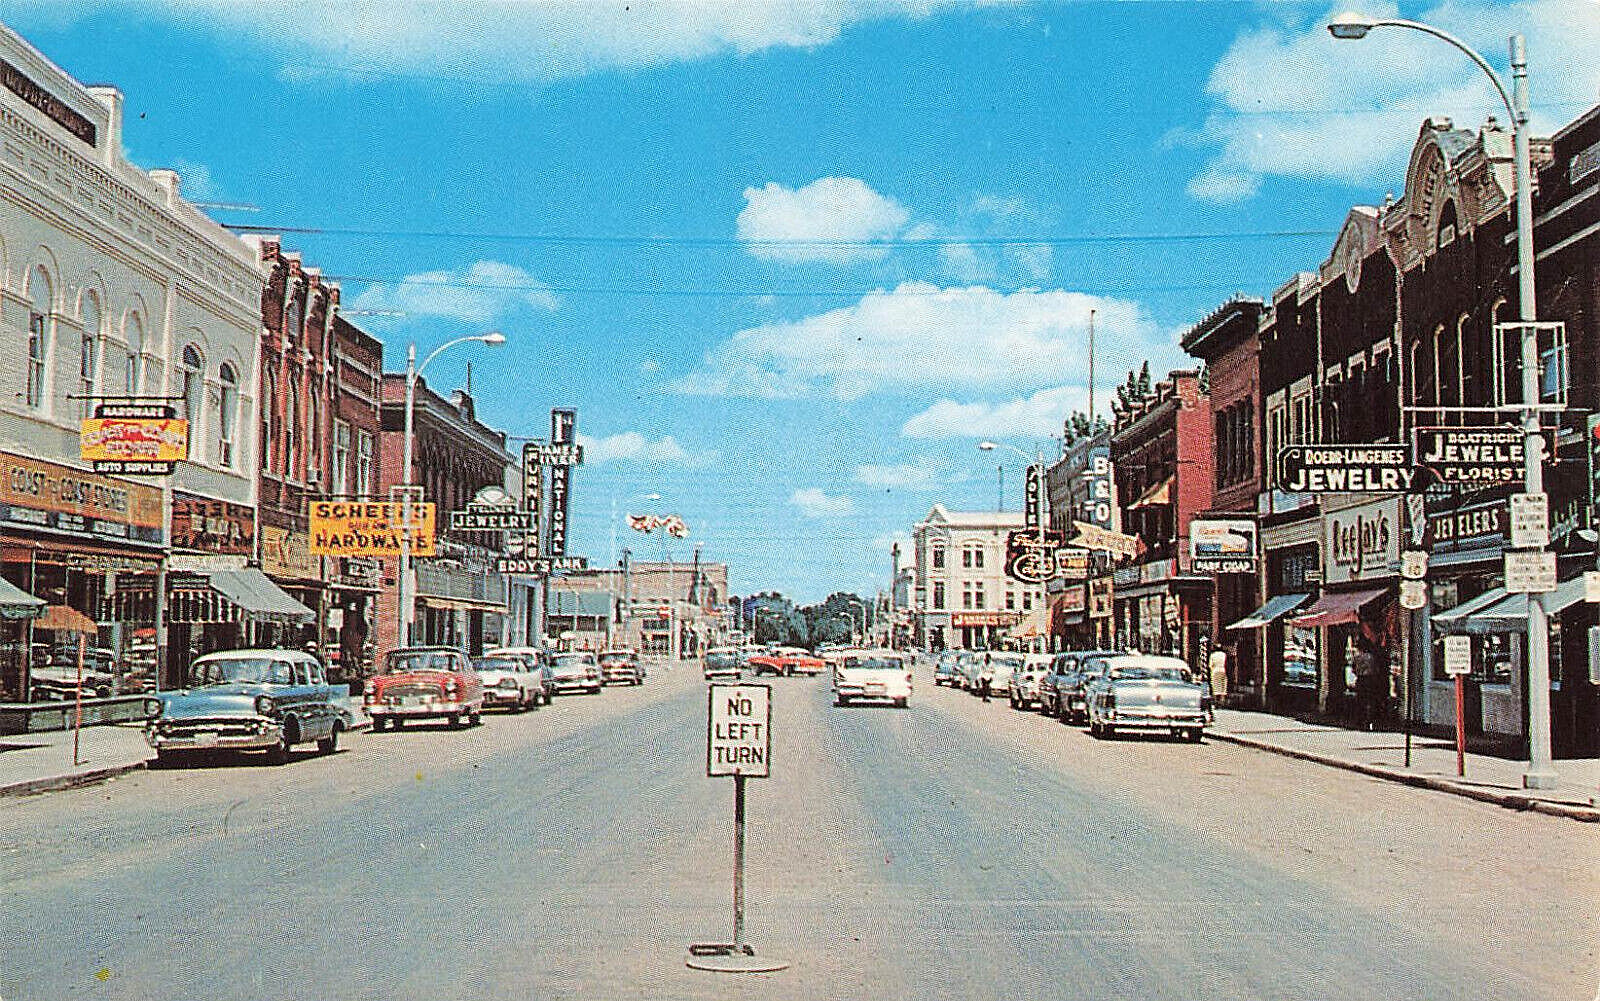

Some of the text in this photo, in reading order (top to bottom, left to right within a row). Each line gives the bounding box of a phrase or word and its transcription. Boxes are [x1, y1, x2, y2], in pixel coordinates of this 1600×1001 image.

[103, 406, 166, 417] HARDWARE
[97, 463, 122, 472] AUTO
[1444, 467, 1526, 480] FLORIST
[10, 466, 46, 495] COAST
[60, 476, 91, 504] COAST
[1290, 468, 1415, 490] JEWELRY
[553, 469, 565, 553] NATIONAL
[454, 514, 530, 528] JEWELRY
[498, 559, 551, 572] EDDY'S
[553, 558, 583, 569] ANK
[727, 698, 752, 716] NO
[716, 722, 762, 740] LEFT
[714, 746, 764, 764] TURN
